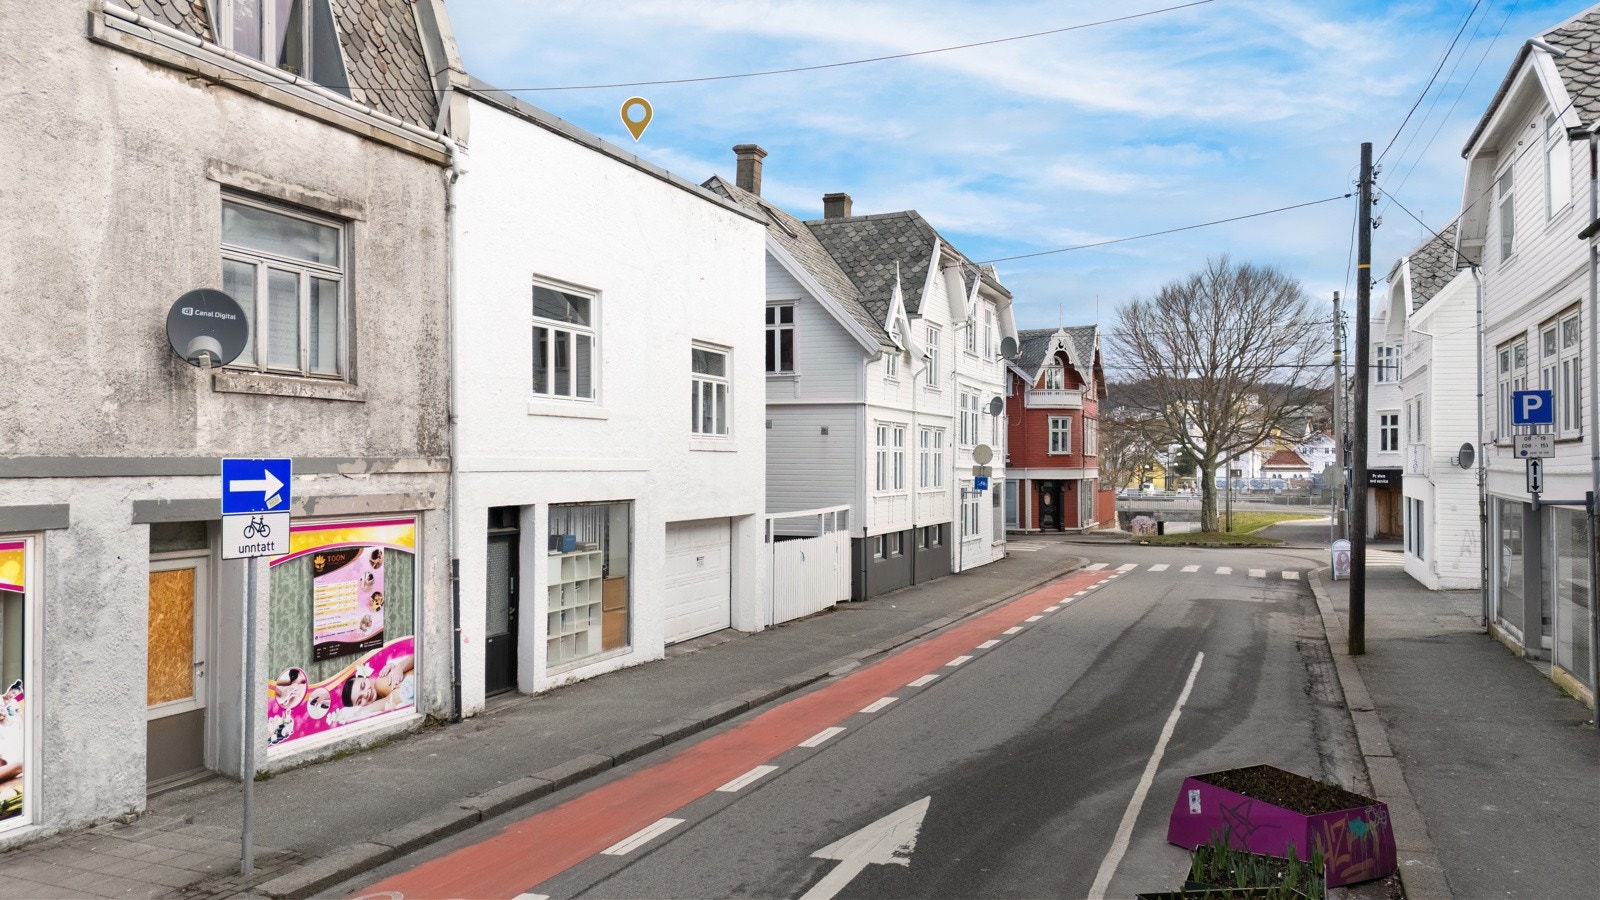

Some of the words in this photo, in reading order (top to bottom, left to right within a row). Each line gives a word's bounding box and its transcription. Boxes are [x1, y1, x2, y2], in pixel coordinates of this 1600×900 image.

[195, 309, 214, 317] Canal
[214, 312, 236, 320] Digital
[1523, 395, 1543, 420] P
[238, 541, 275, 553] unntatt
[327, 554, 346, 562] TOON
